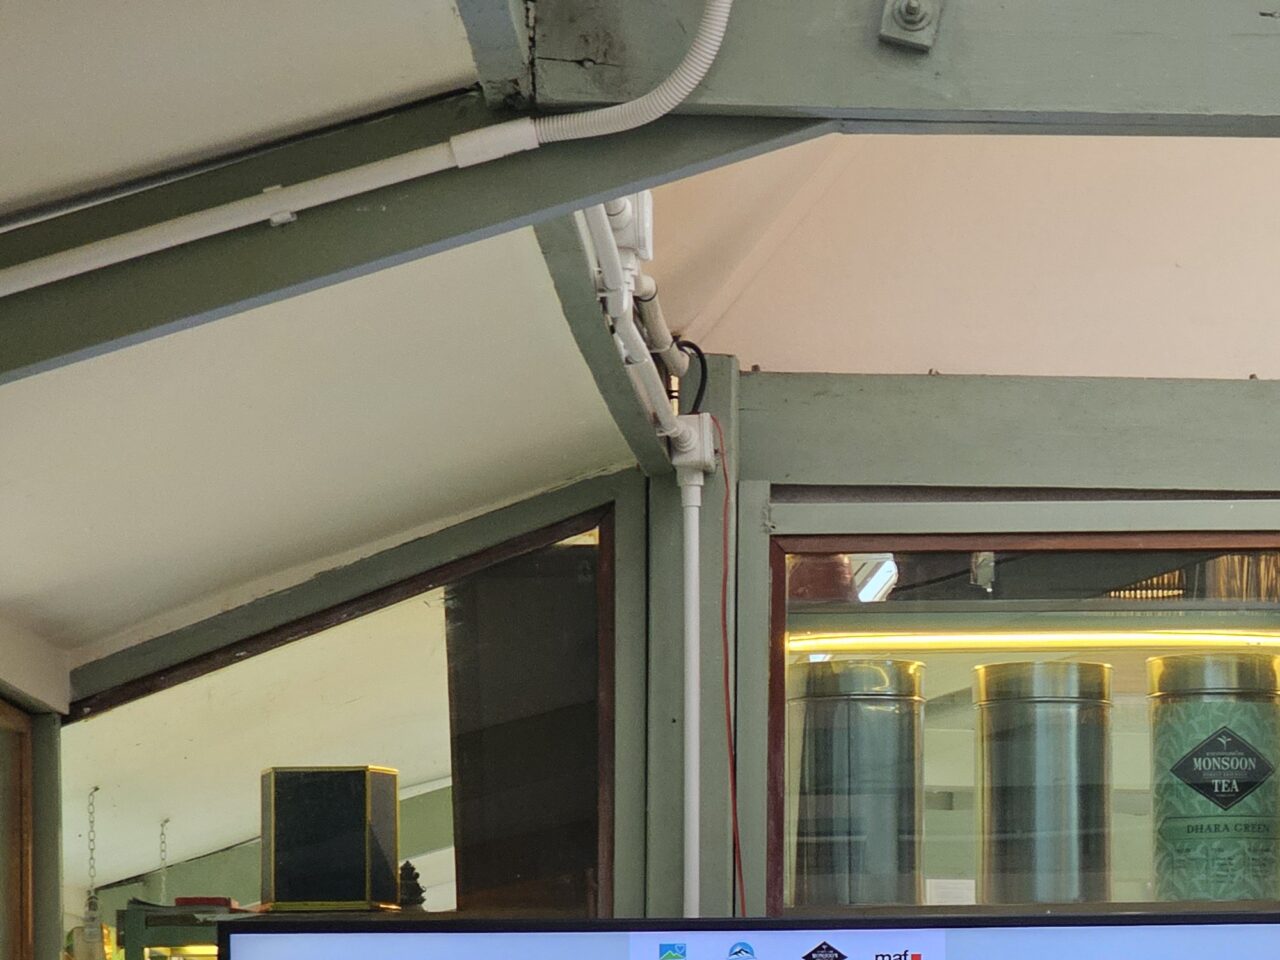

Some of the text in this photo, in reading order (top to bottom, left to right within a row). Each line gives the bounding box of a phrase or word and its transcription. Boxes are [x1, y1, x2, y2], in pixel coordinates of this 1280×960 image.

[1193, 757, 1256, 771] MONSOON
[1212, 779, 1239, 793] TEA
[1186, 823, 1270, 834] DHARA GREEN
